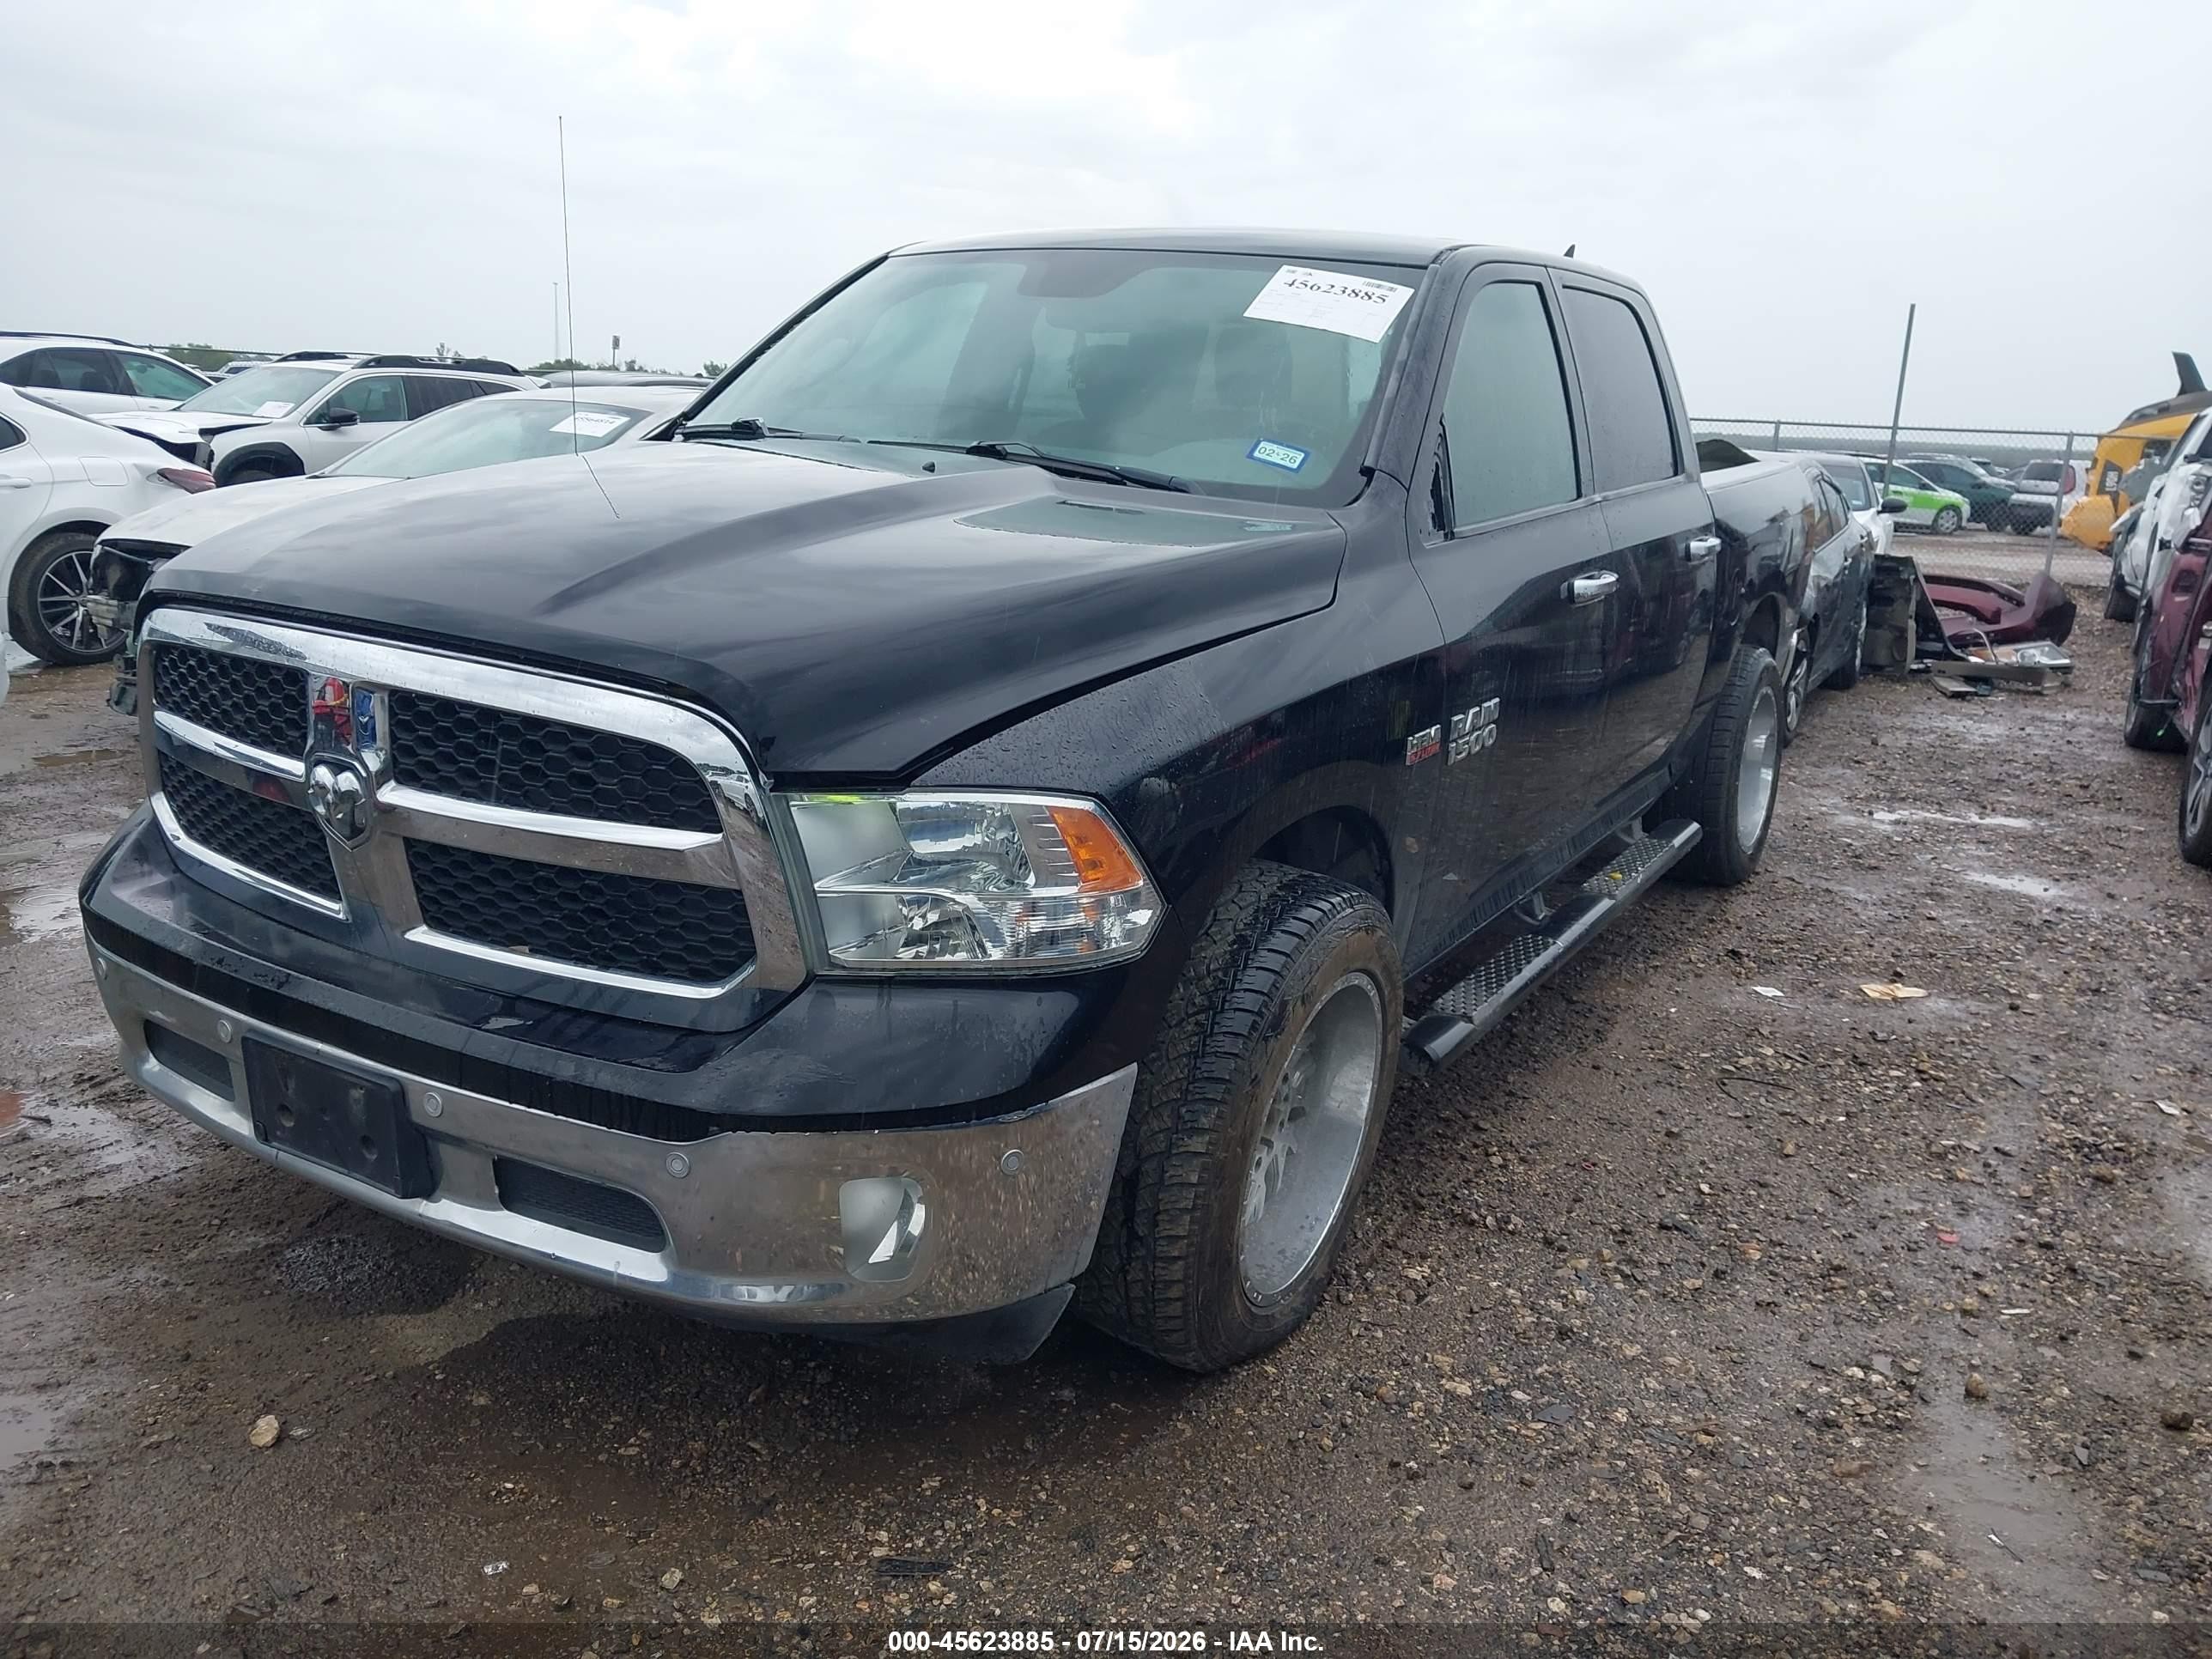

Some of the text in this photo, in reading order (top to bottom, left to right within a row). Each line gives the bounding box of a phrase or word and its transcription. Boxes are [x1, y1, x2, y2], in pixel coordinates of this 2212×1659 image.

[1284, 278, 1389, 304] 45623885
[1449, 697, 1500, 741] RAM
[1448, 724, 1497, 766] 1500
